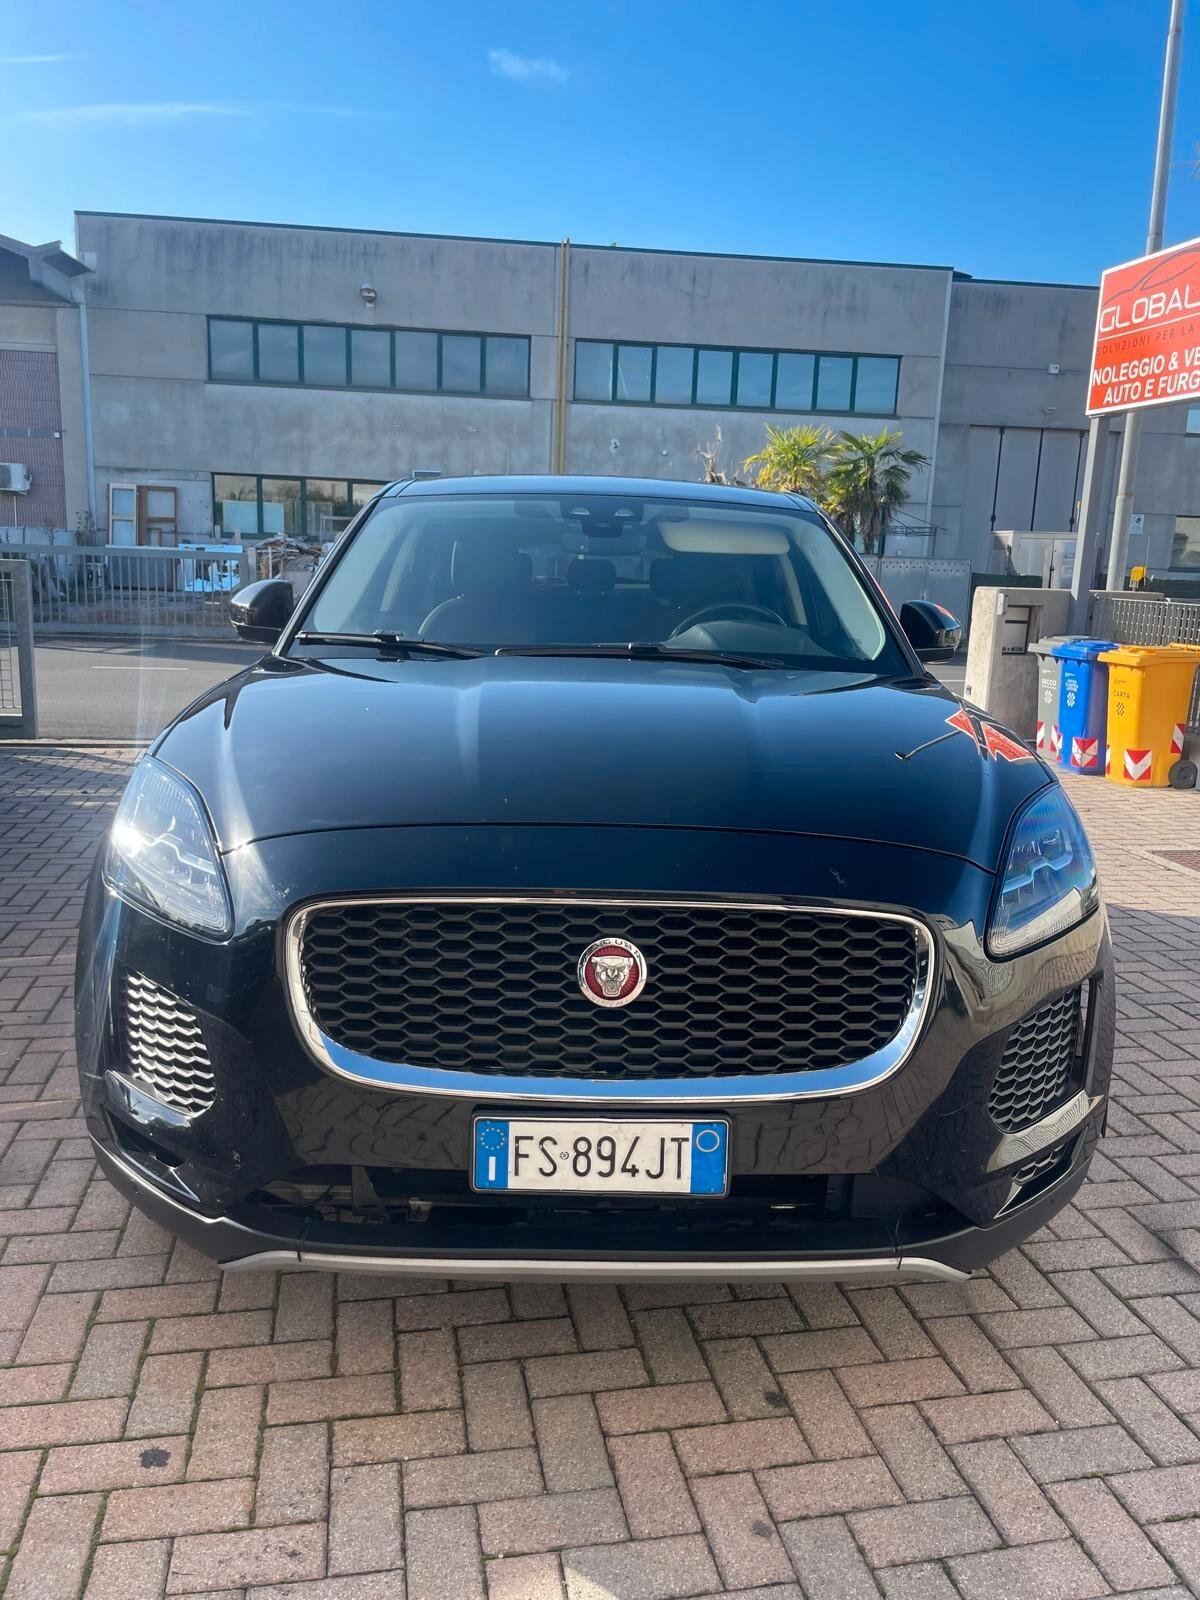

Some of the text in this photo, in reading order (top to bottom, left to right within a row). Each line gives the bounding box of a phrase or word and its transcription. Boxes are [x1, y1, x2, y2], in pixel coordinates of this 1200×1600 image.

[1100, 284, 1200, 332] GLOBAL
[1156, 328, 1175, 342] PER
[1181, 324, 1194, 336] LA
[1093, 354, 1165, 386] NOLEGGIO
[1168, 352, 1178, 371] &
[1103, 369, 1200, 405] AUTO E FURG
[1113, 690, 1130, 699] CARTA
